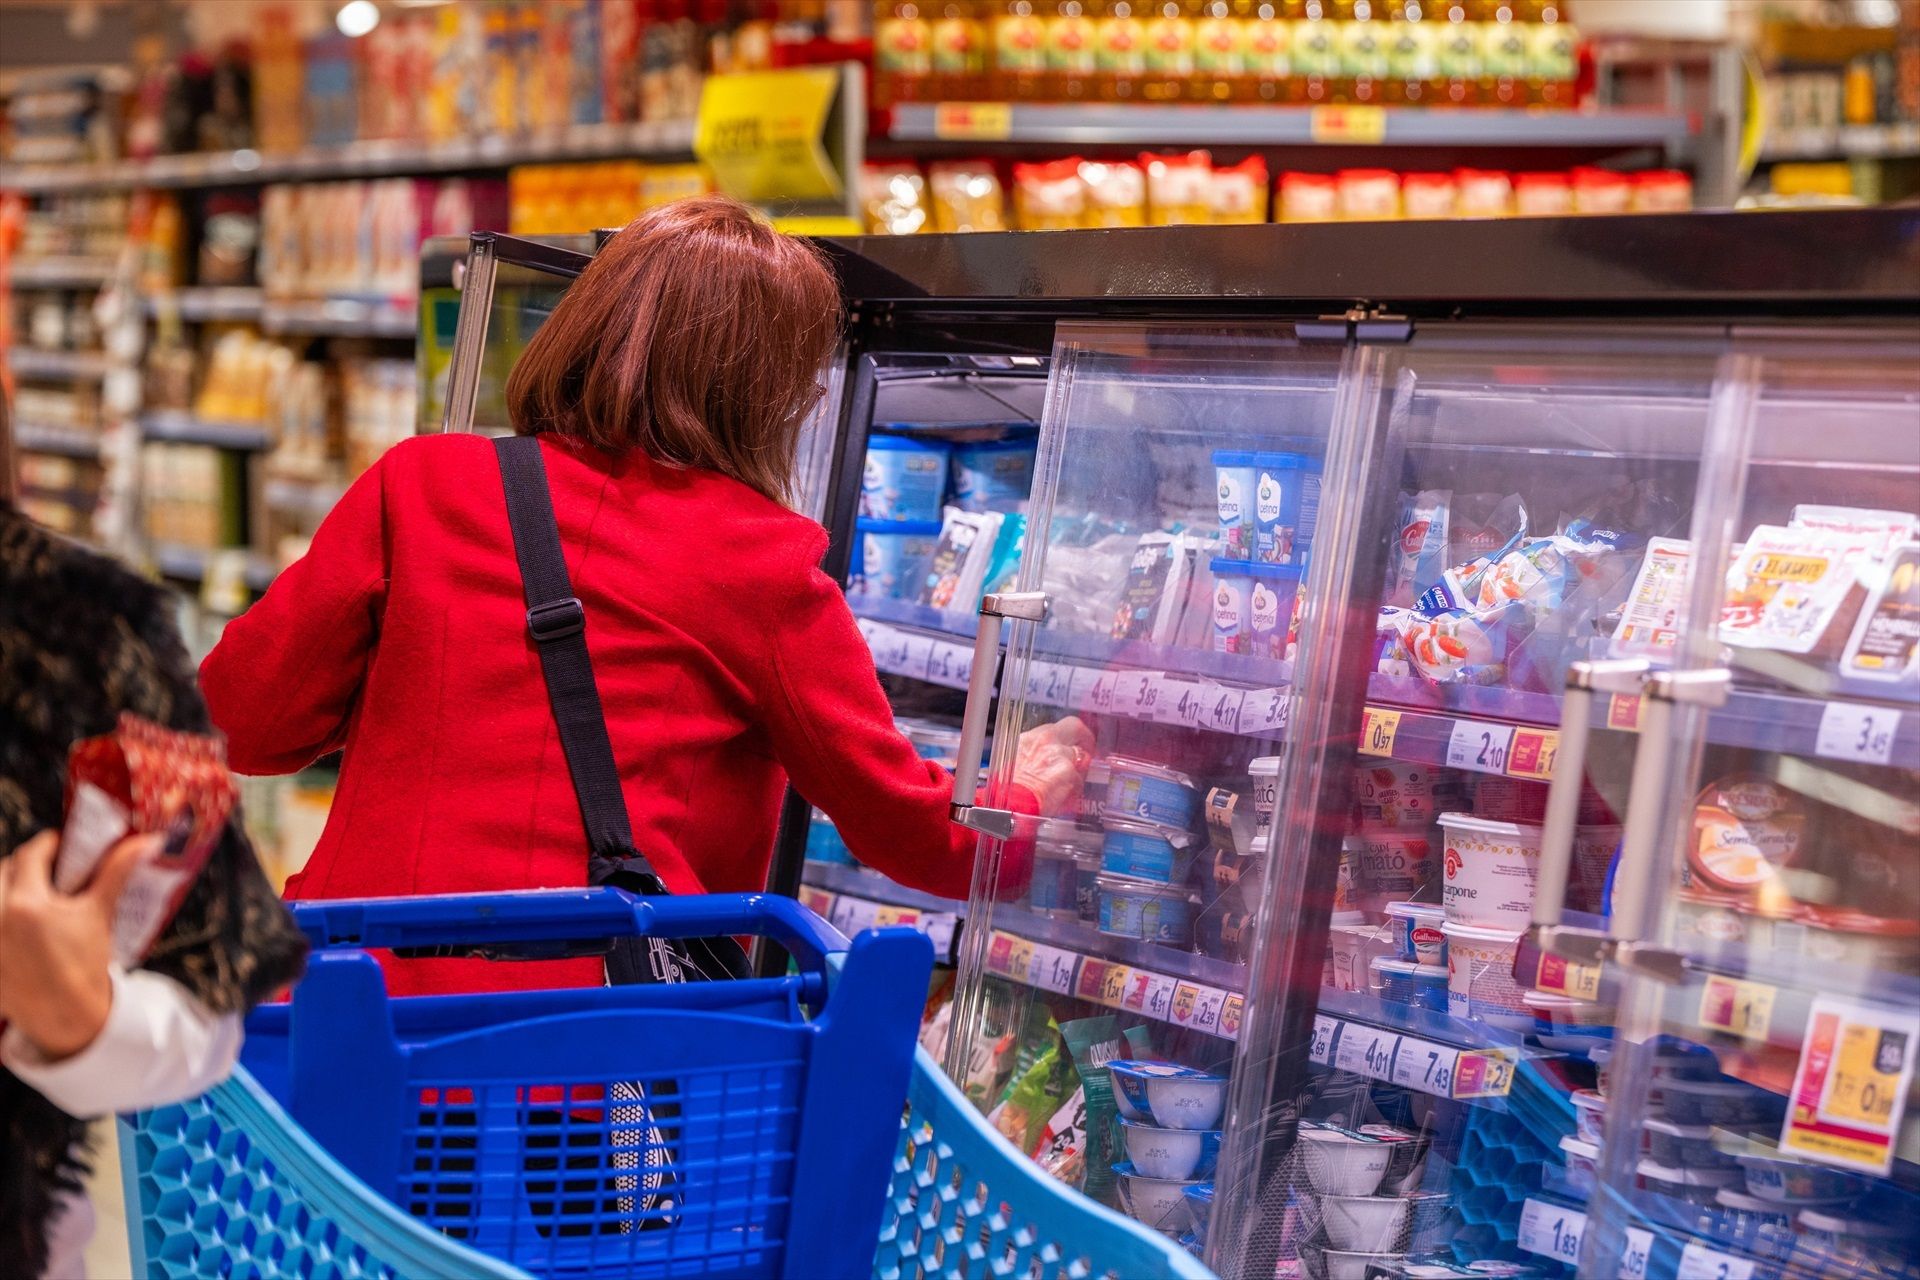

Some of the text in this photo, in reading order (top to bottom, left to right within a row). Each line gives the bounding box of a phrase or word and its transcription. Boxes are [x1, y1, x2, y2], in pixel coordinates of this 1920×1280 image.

[1177, 689, 1199, 720] 4,17
[1214, 693, 1236, 725] 4,17
[1372, 723, 1391, 748] 0,97
[1476, 731, 1503, 767] 2,10
[1198, 1001, 1215, 1026] 2,39
[1364, 1037, 1389, 1076] 4,01
[1424, 1051, 1449, 1090] 7,43
[1552, 1217, 1577, 1257] 1,83
